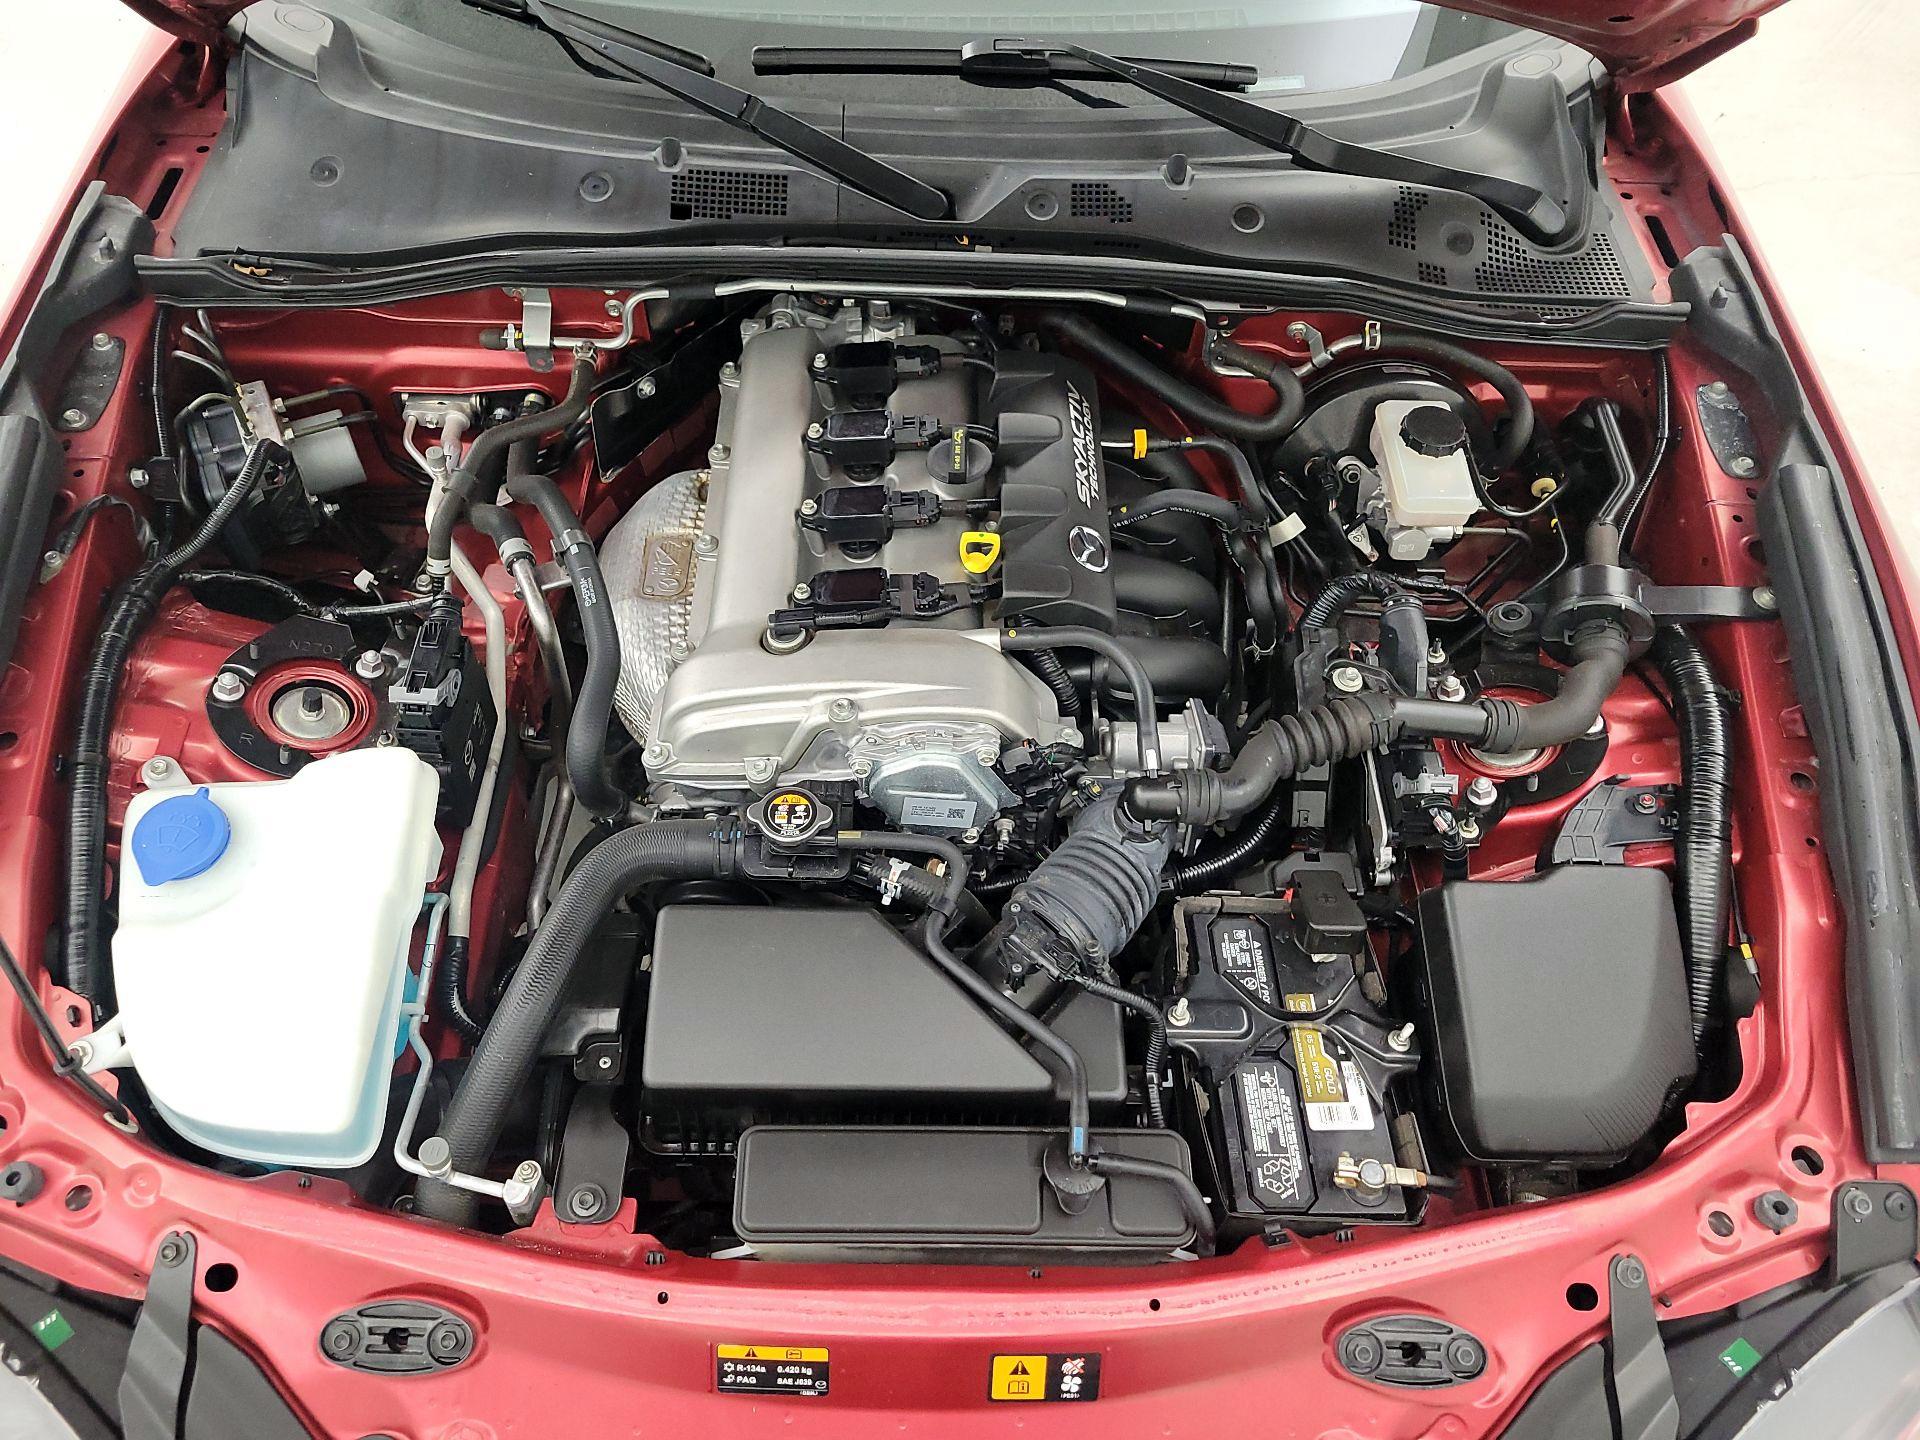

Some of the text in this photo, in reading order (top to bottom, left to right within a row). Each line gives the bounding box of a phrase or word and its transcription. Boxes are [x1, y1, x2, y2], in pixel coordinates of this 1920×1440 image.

[1066, 379, 1092, 510] SKYACTIV
[1080, 395, 1100, 501] TECHNOLOGY
[1254, 949, 1267, 983] DANGER
[1324, 1067, 1336, 1094] GOLD
[736, 1364, 813, 1375] R-134a 0.420 kg
[736, 1375, 757, 1385] PAG
